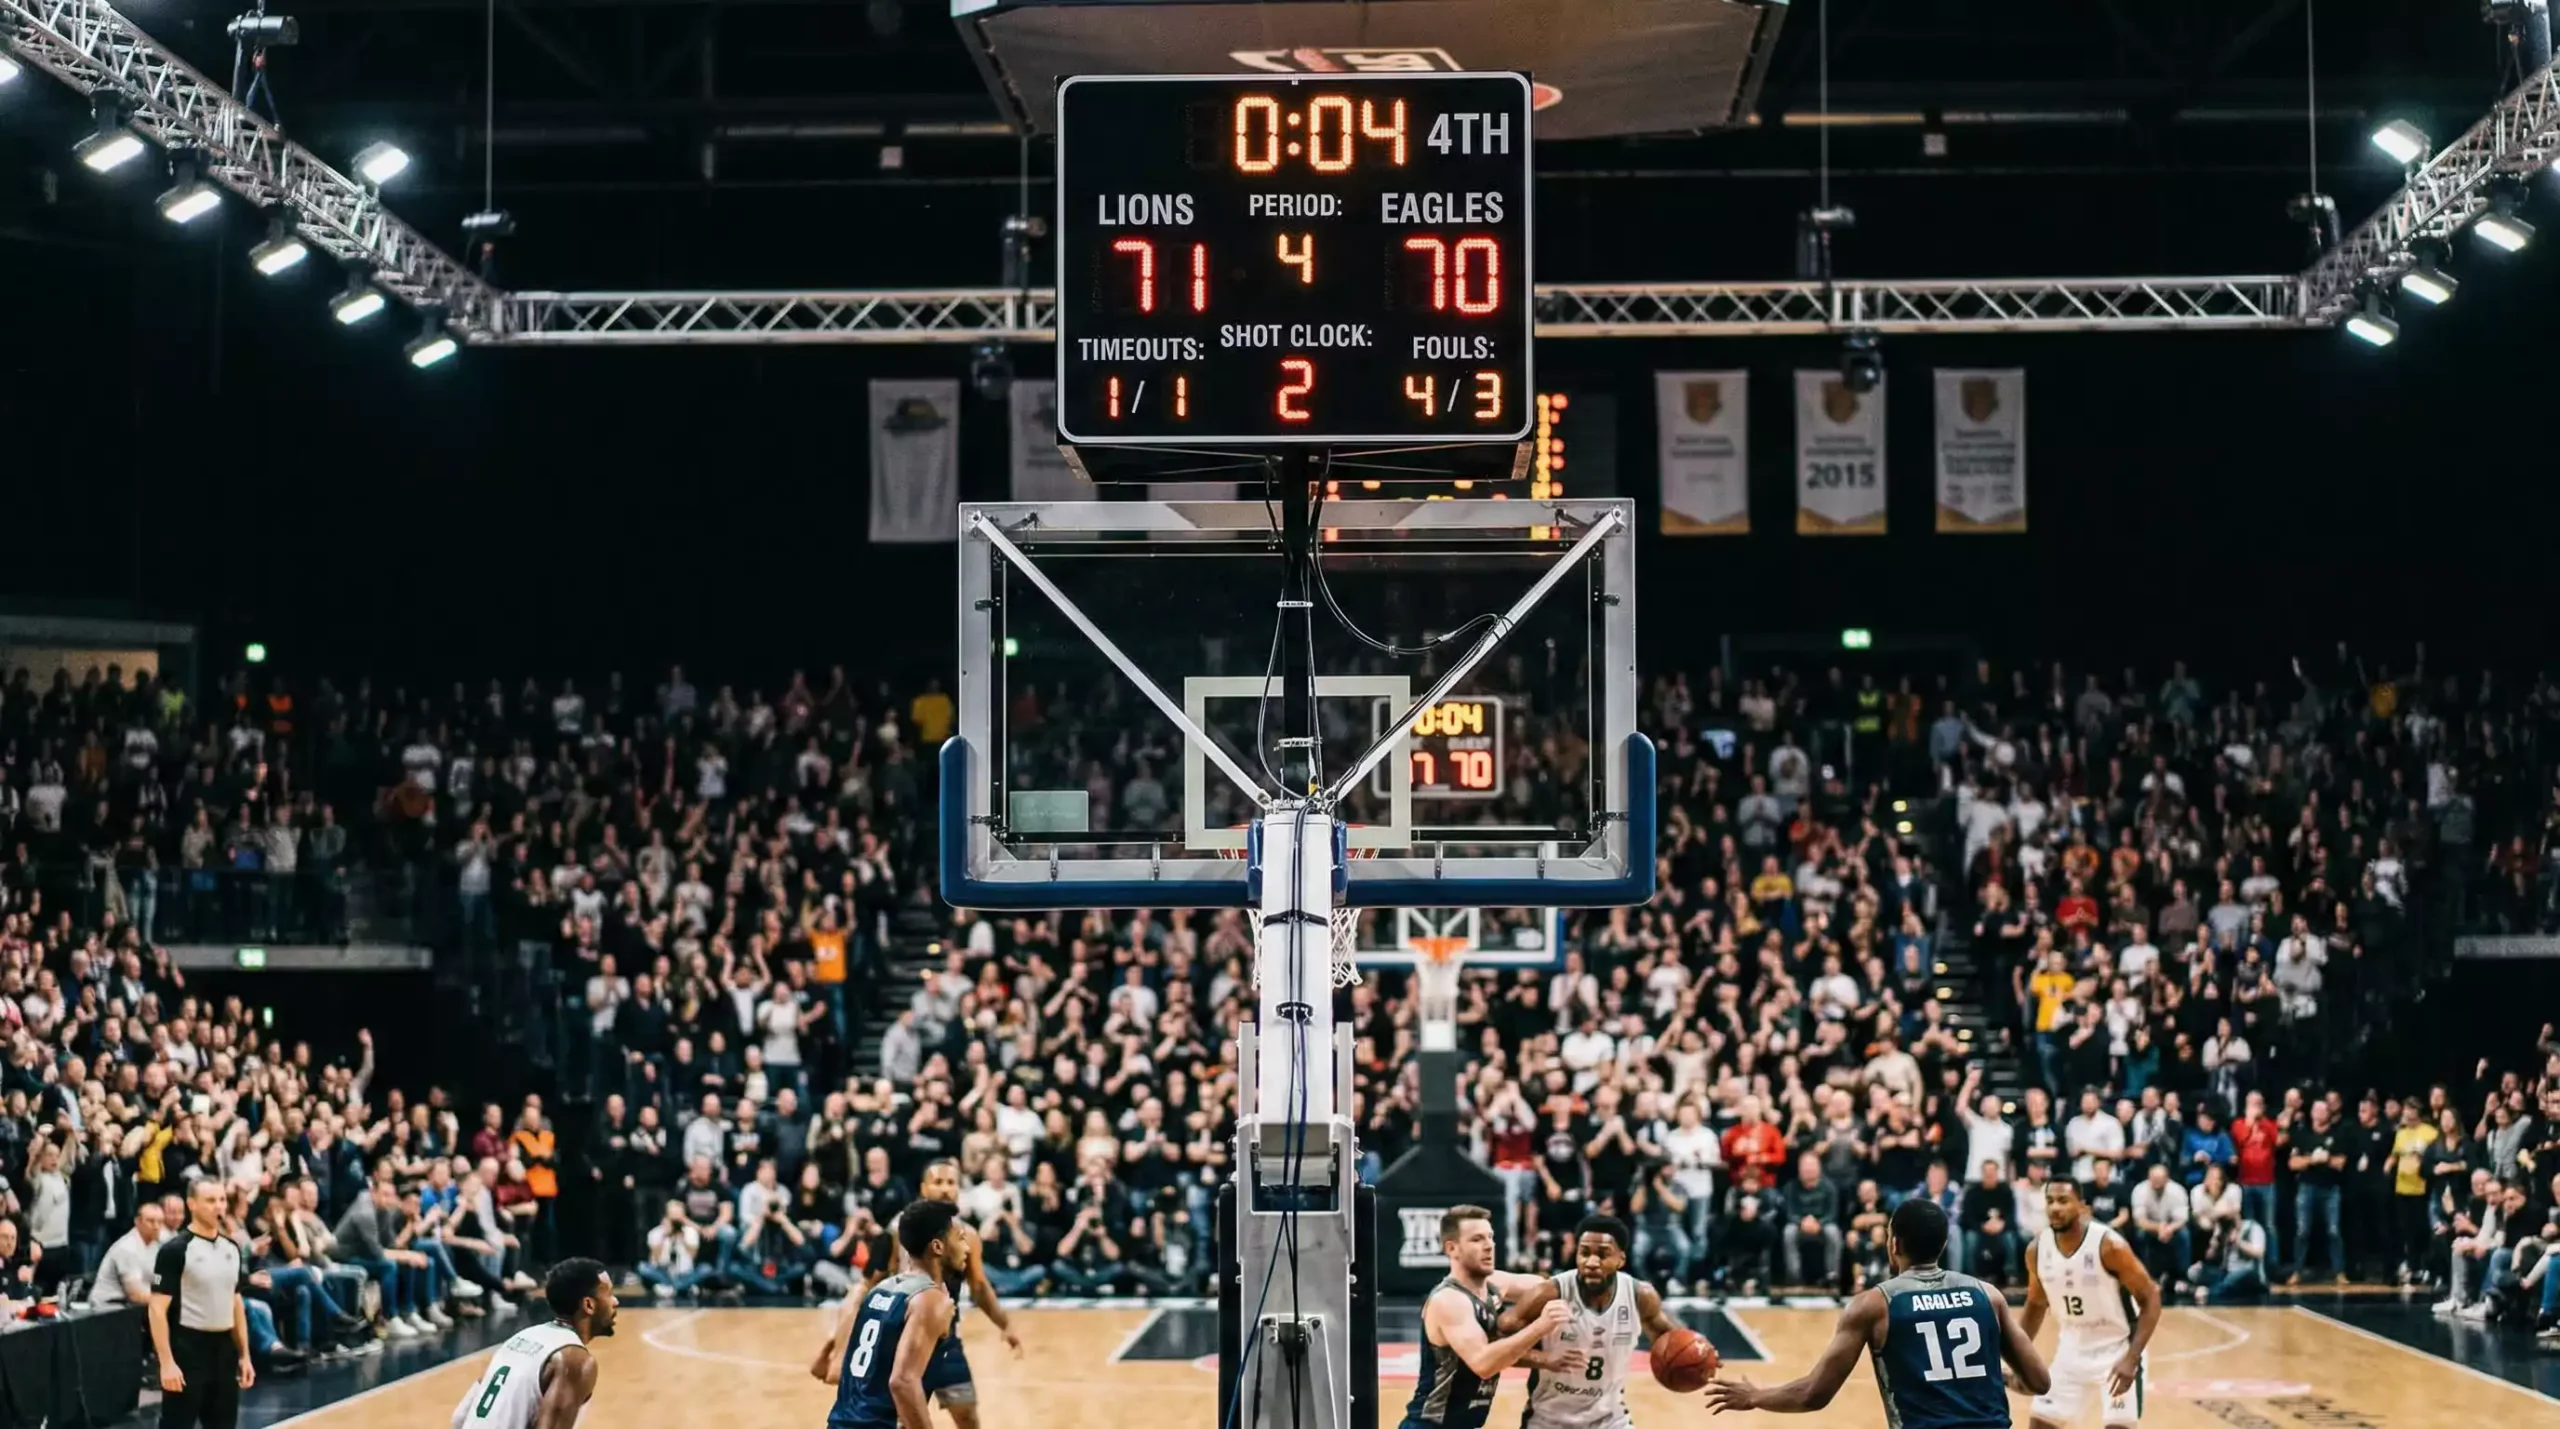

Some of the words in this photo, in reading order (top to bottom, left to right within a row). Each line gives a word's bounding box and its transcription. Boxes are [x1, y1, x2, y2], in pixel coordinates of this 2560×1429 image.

[1234, 95, 1408, 172] 0:04
[1427, 112, 1509, 155] 4TH
[1099, 193, 1194, 225] LIONS
[1249, 193, 1343, 217] PERIOD:
[1381, 191, 1504, 224] EAGLES
[1112, 238, 1208, 313] 71
[1277, 232, 1314, 284] 4
[1404, 236, 1502, 316] 70
[1077, 337, 1205, 361] TIMEOUTS:
[1220, 324, 1282, 348] SHOT
[1290, 323, 1373, 347] CLOCK:
[1413, 335, 1495, 360] FOULS:
[1276, 359, 1314, 421] 2
[1805, 461, 1876, 489] 2015
[1449, 751, 1493, 788] 70
[2063, 1295, 2084, 1316] 13
[849, 1318, 881, 1378] 8
[1914, 1316, 1987, 1382] 12
[1585, 1356, 1605, 1381] 8
[476, 1365, 511, 1418] 6
